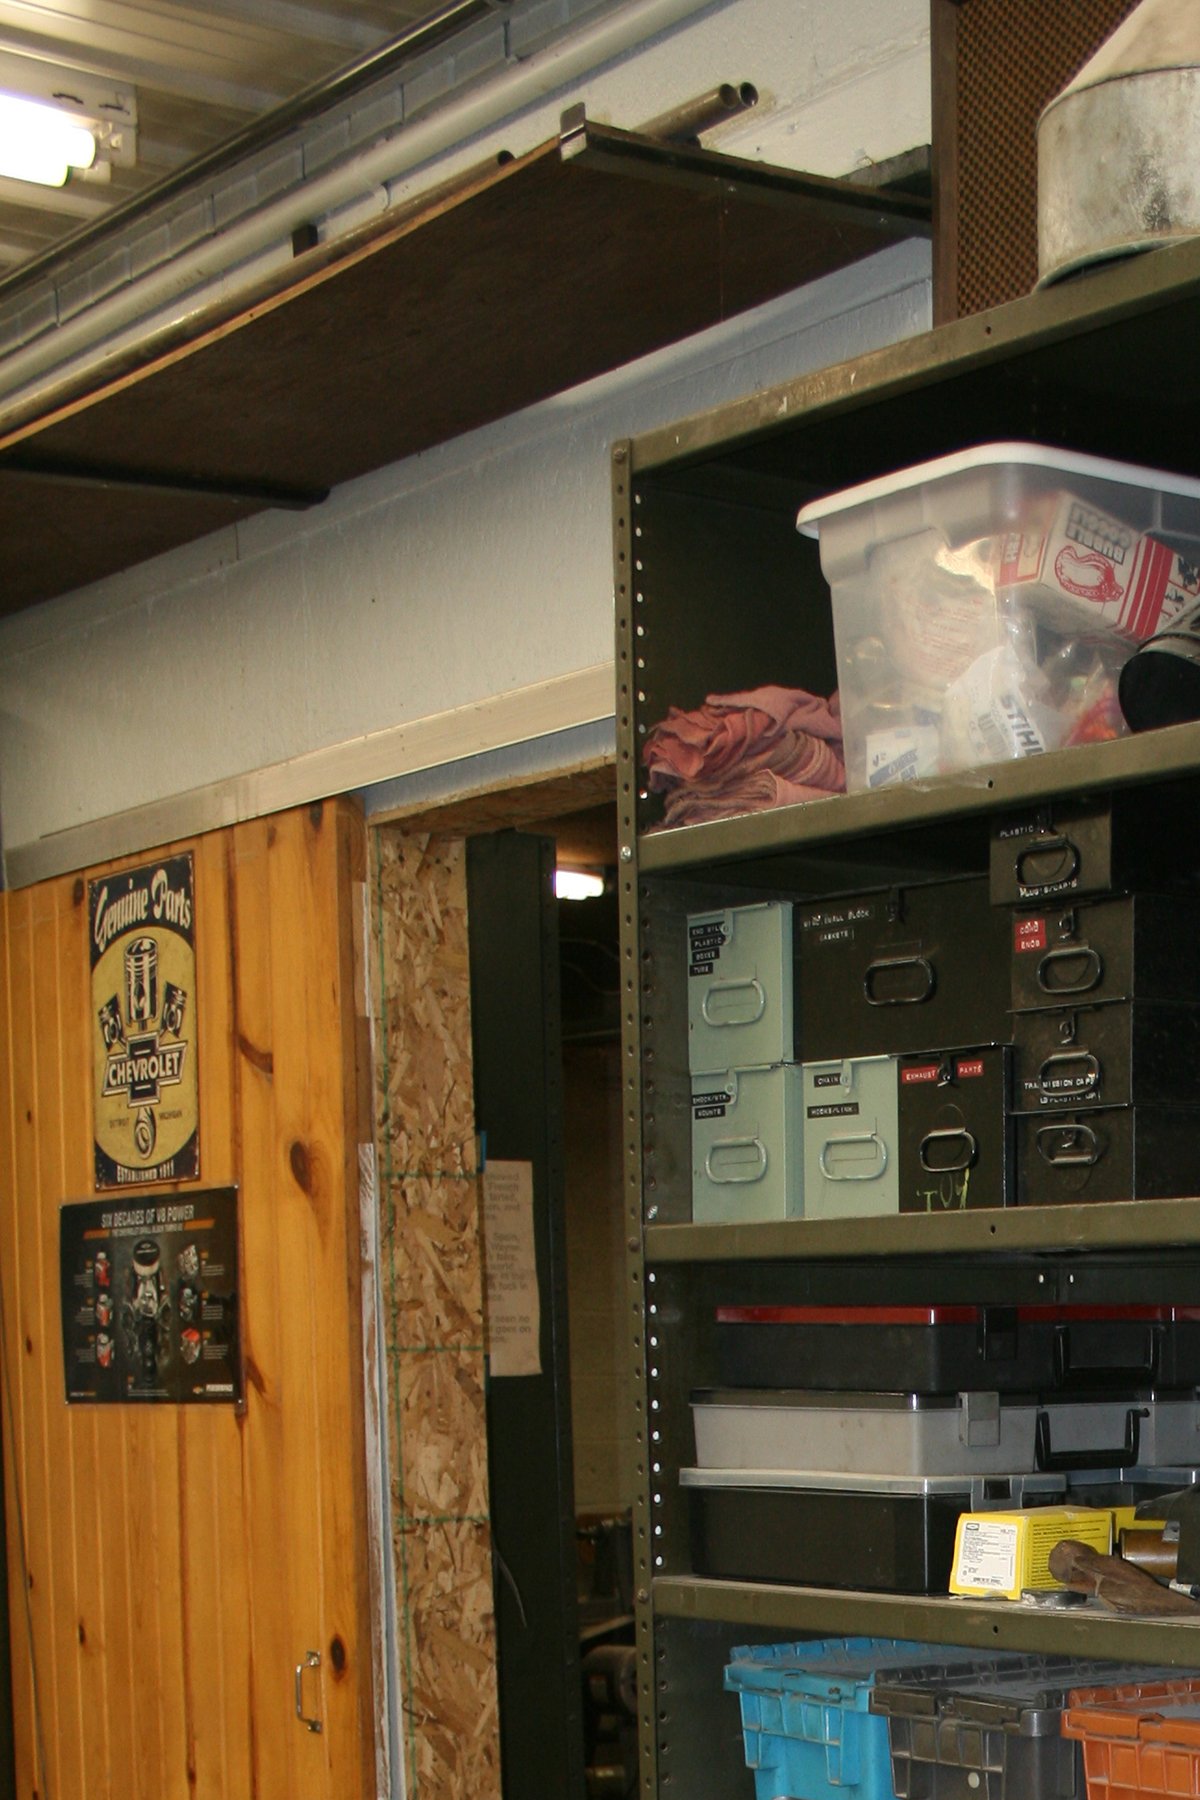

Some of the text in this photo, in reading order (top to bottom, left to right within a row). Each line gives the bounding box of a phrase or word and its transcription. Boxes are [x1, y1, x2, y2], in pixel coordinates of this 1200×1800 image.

[1000, 825, 1034, 838] PLASTIC
[94, 868, 193, 954] Genuine Parts
[108, 1049, 182, 1086] CHEVROLET
[905, 1070, 937, 1082] EXHAUST
[116, 1162, 175, 1183] ESTABLISHED 1911
[101, 1212, 113, 1228] SIX
[113, 1208, 145, 1226] DECADES
[146, 1207, 156, 1224] OF
[156, 1207, 166, 1223] V8
[166, 1204, 195, 1223] POWER
